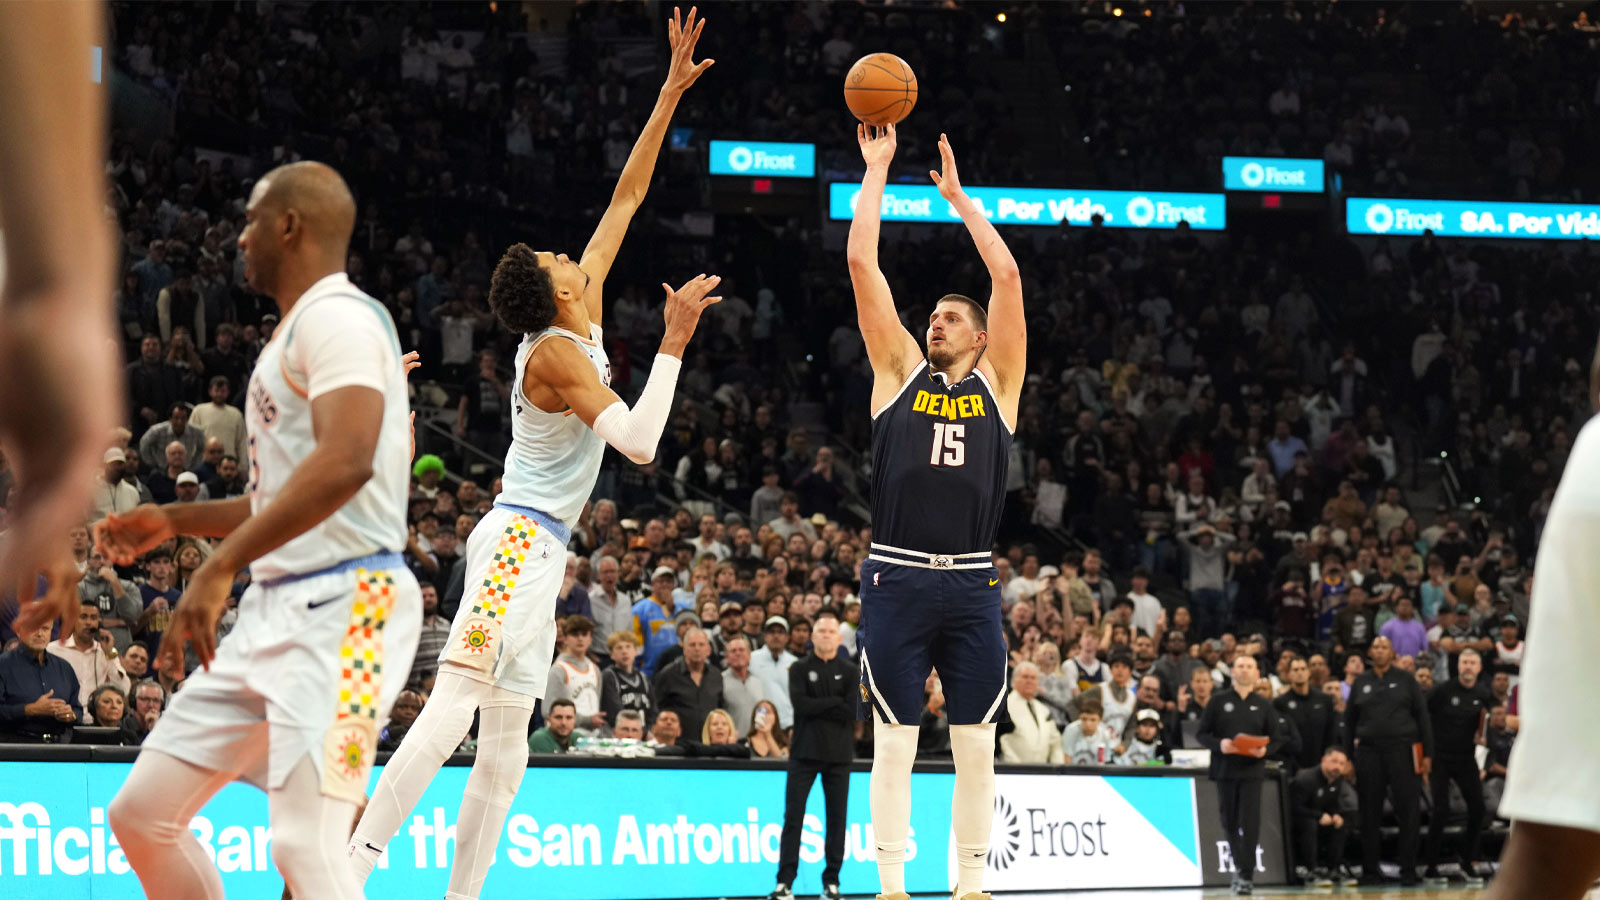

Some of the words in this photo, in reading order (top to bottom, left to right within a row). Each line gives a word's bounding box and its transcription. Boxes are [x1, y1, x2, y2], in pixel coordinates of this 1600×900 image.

[754, 150, 795, 171] Frost
[1265, 166, 1306, 186] Frost
[881, 194, 931, 216] Frost
[998, 198, 1044, 220] Por
[1156, 201, 1206, 224] Frost
[1395, 208, 1444, 231] Frost
[1460, 211, 1504, 233] SA.
[1508, 212, 1552, 234] Por
[1556, 212, 1600, 236] Vid
[930, 422, 965, 466] 15
[507, 813, 603, 868] San
[612, 807, 783, 866] Antonio
[1026, 807, 1109, 858] Frost
